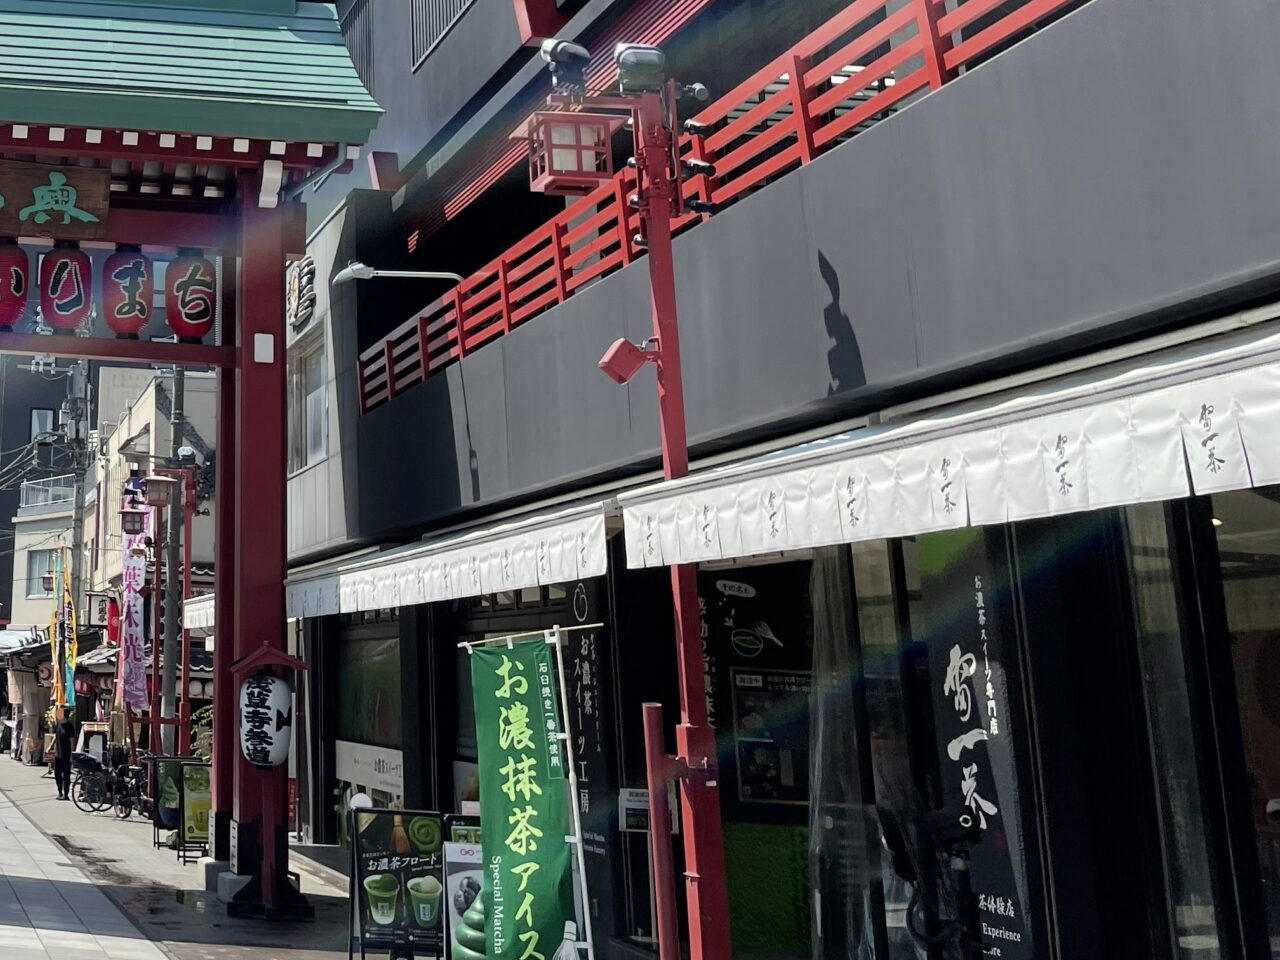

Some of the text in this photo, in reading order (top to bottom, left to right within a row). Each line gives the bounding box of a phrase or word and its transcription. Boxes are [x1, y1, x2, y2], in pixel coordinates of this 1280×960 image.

[489, 855, 505, 954] Special Matcha
[981, 922, 1021, 942] Experience
